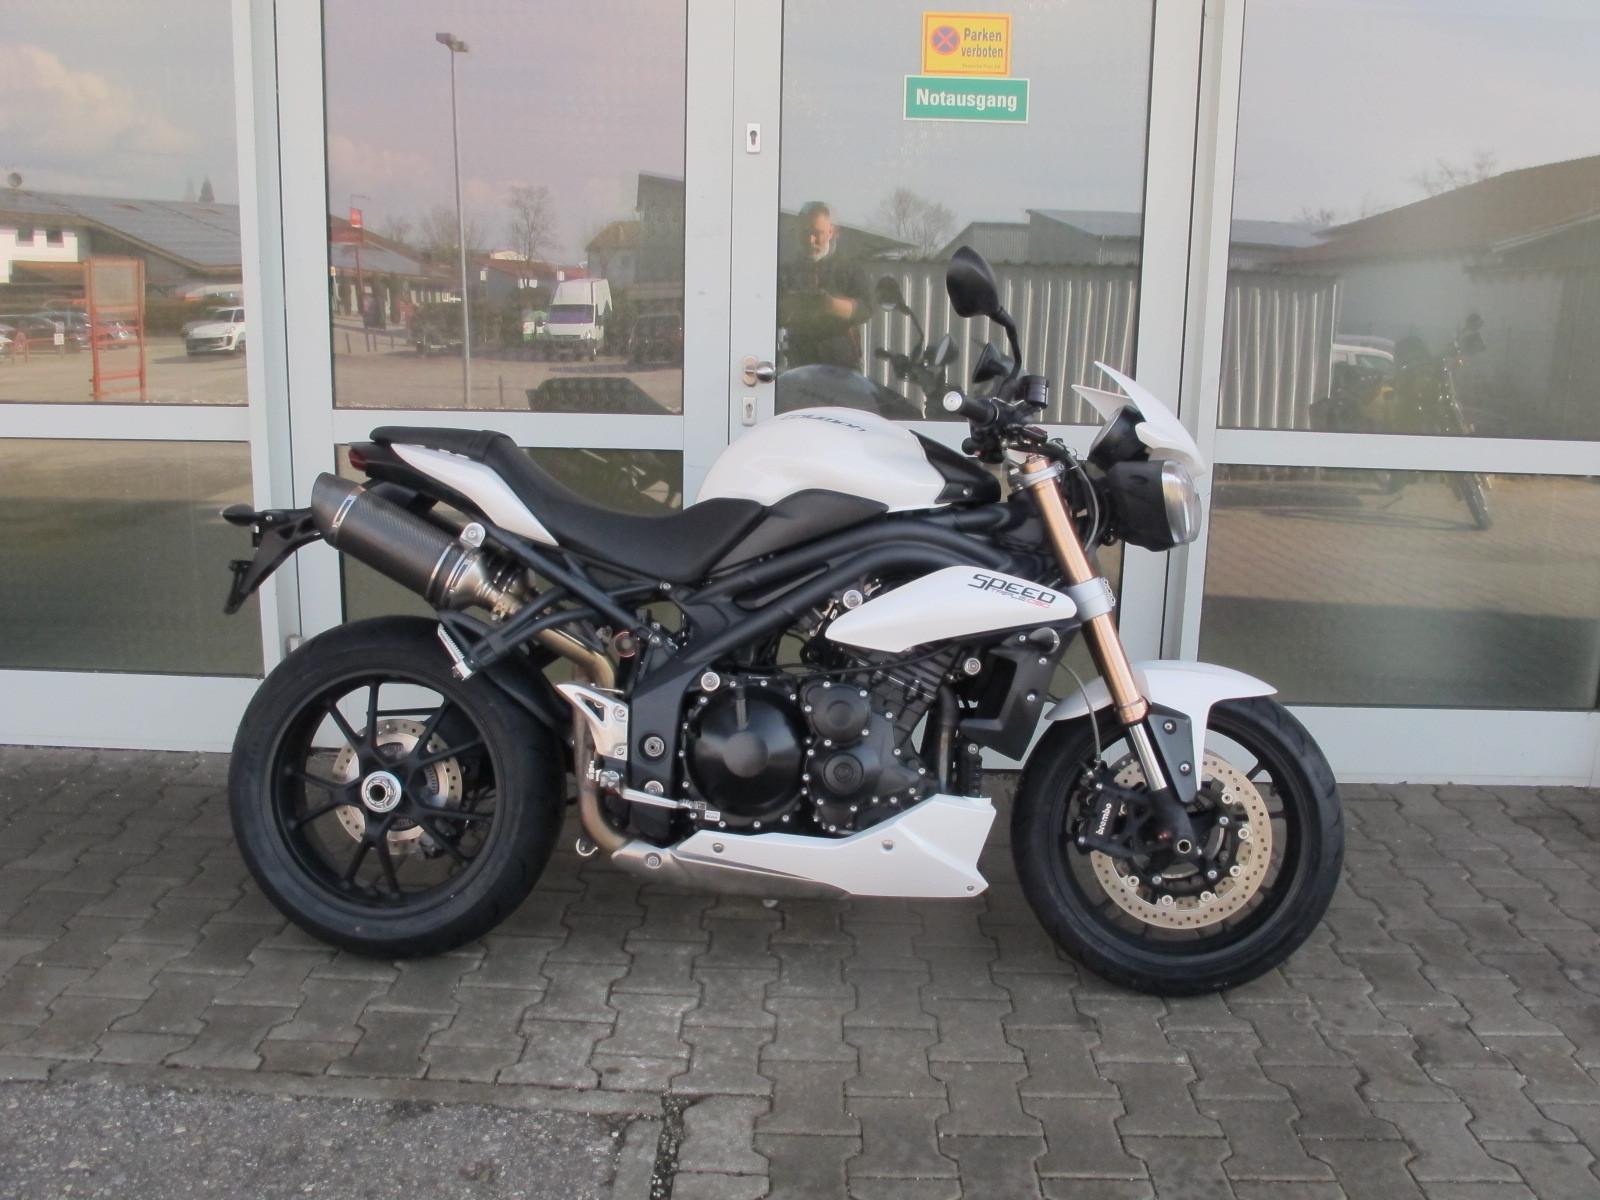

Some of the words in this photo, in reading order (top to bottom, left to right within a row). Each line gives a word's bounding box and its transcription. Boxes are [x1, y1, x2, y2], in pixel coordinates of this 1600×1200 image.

[964, 27, 1002, 42] Parken
[961, 44, 1003, 58] verboten
[916, 88, 1017, 112] Notausgang
[968, 573, 1056, 604] SPEED
[1095, 802, 1112, 835] brembo
